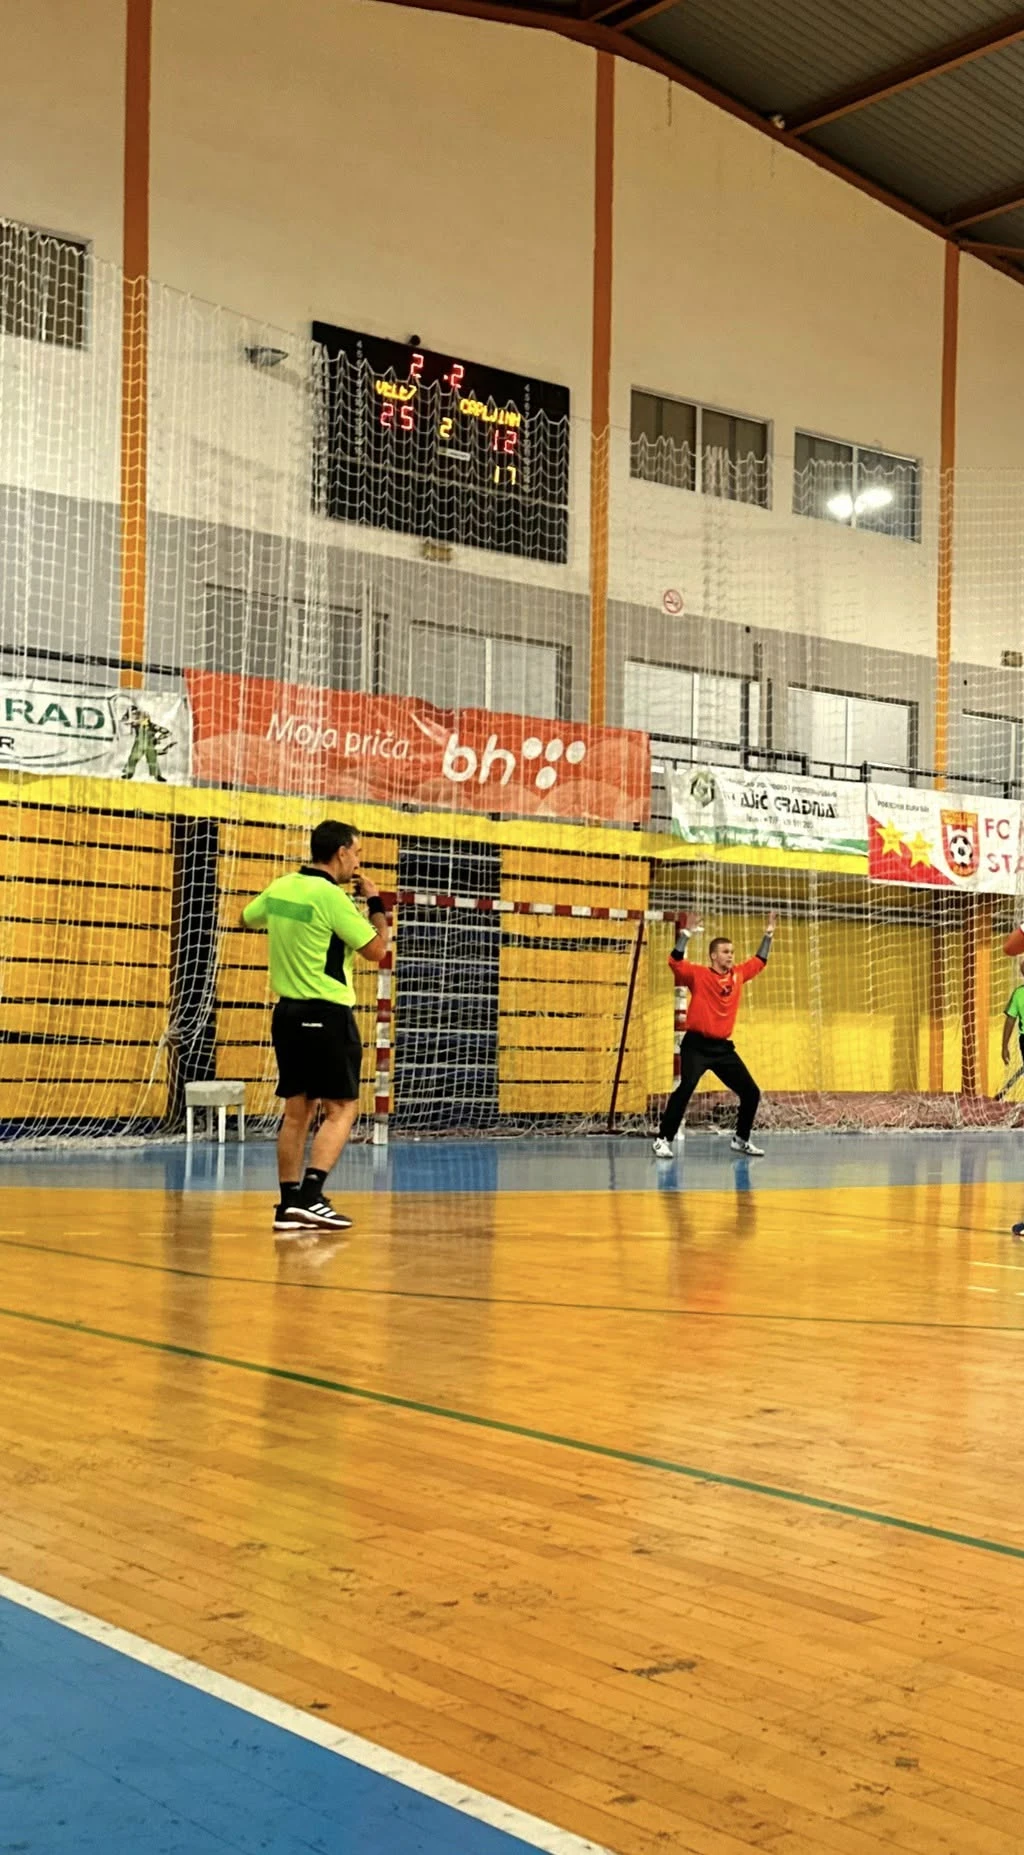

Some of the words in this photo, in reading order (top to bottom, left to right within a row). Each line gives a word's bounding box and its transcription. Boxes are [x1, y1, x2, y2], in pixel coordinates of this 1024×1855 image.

[380, 402, 414, 431] 25
[439, 417, 452, 438] 2
[493, 429, 517, 455] 12
[266, 712, 337, 754] Moja
[985, 817, 1011, 841] FC
